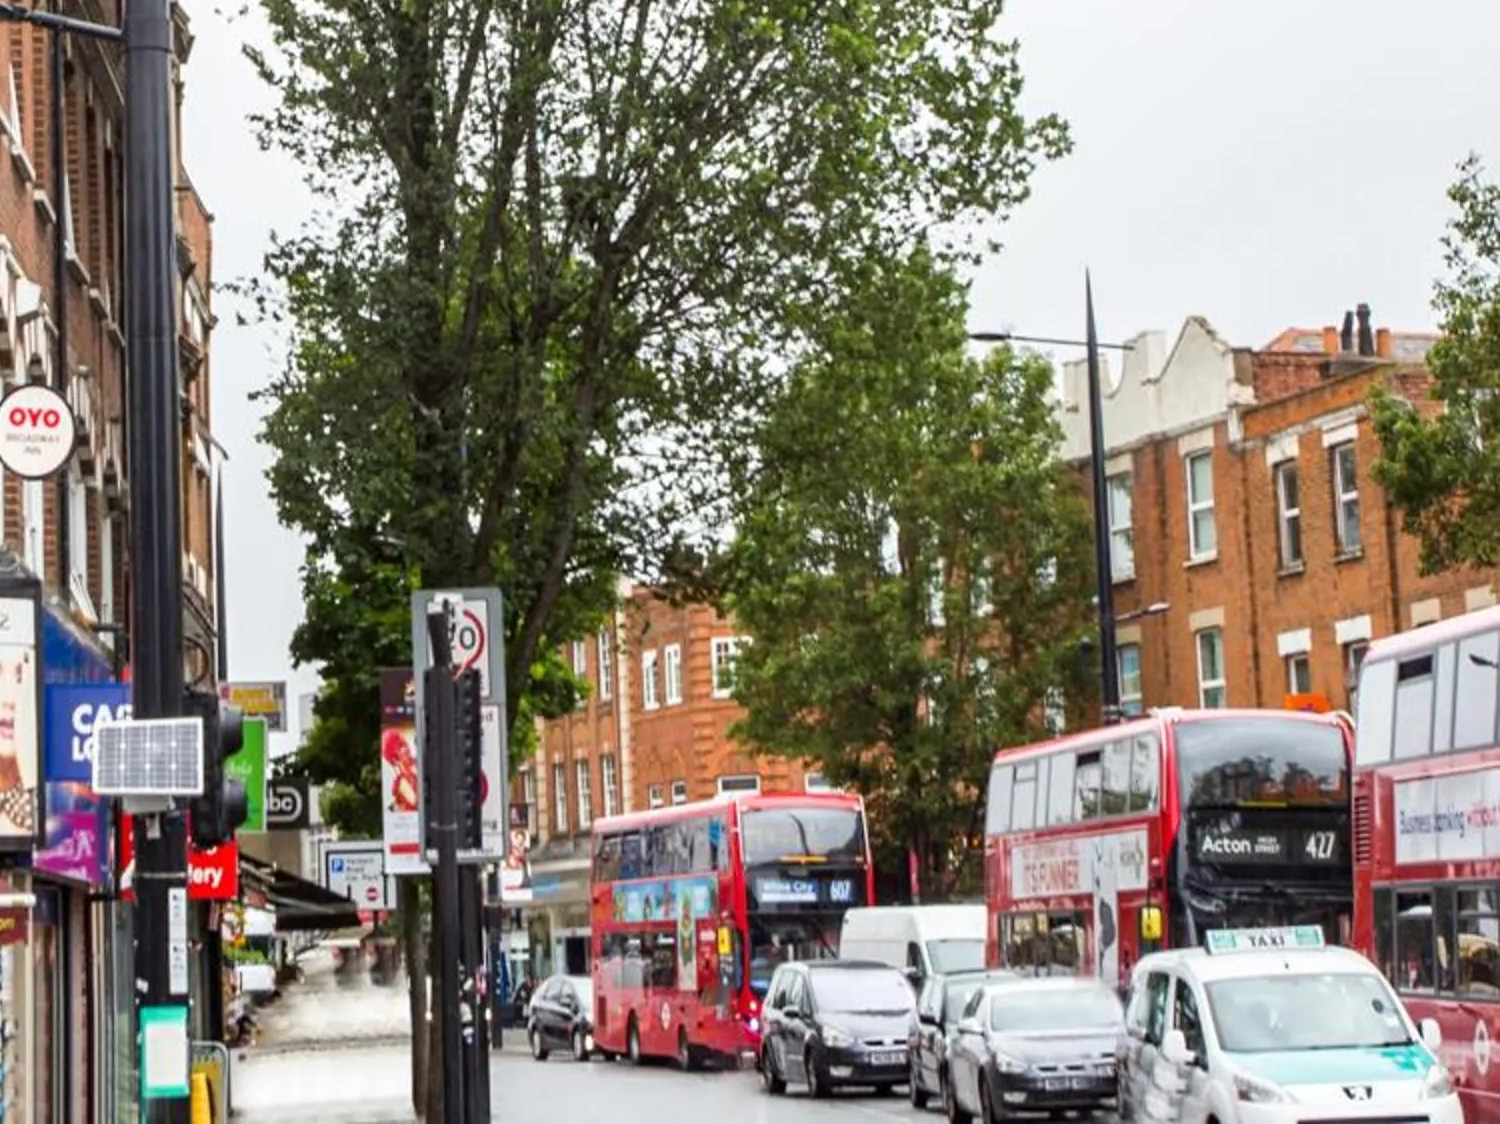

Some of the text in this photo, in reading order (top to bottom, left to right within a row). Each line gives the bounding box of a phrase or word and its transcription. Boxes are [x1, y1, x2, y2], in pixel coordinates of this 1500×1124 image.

[9, 408, 60, 428] OYO
[1202, 831, 1335, 859] Acton 427
[830, 880, 851, 902] 607
[1249, 935, 1285, 948] TAXI
